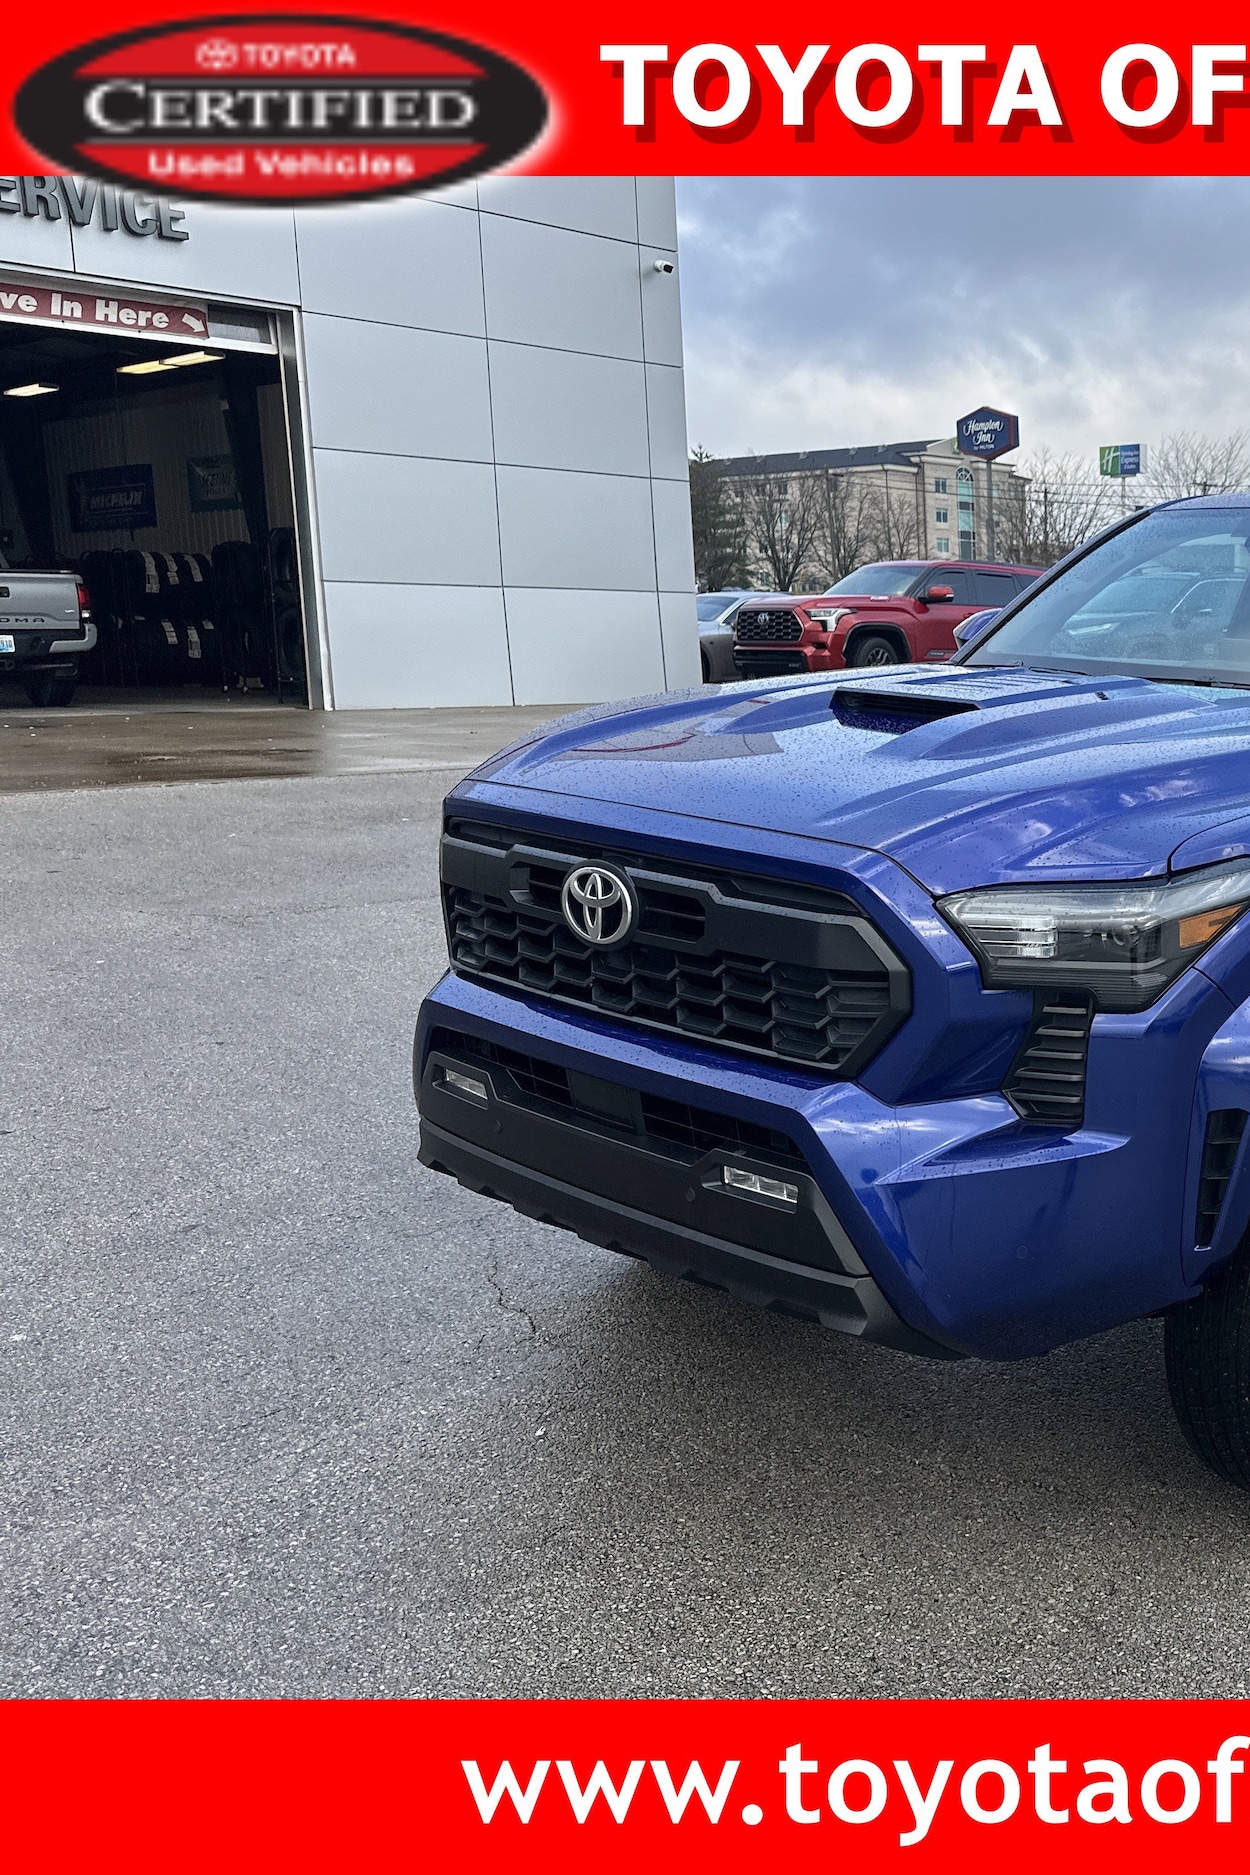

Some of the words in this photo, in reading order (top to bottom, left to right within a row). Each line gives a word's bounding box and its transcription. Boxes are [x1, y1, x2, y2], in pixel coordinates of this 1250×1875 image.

[51, 293, 83, 318] In
[95, 298, 170, 329] Here
[963, 419, 1004, 436] Hampton
[972, 431, 995, 445] Inn
